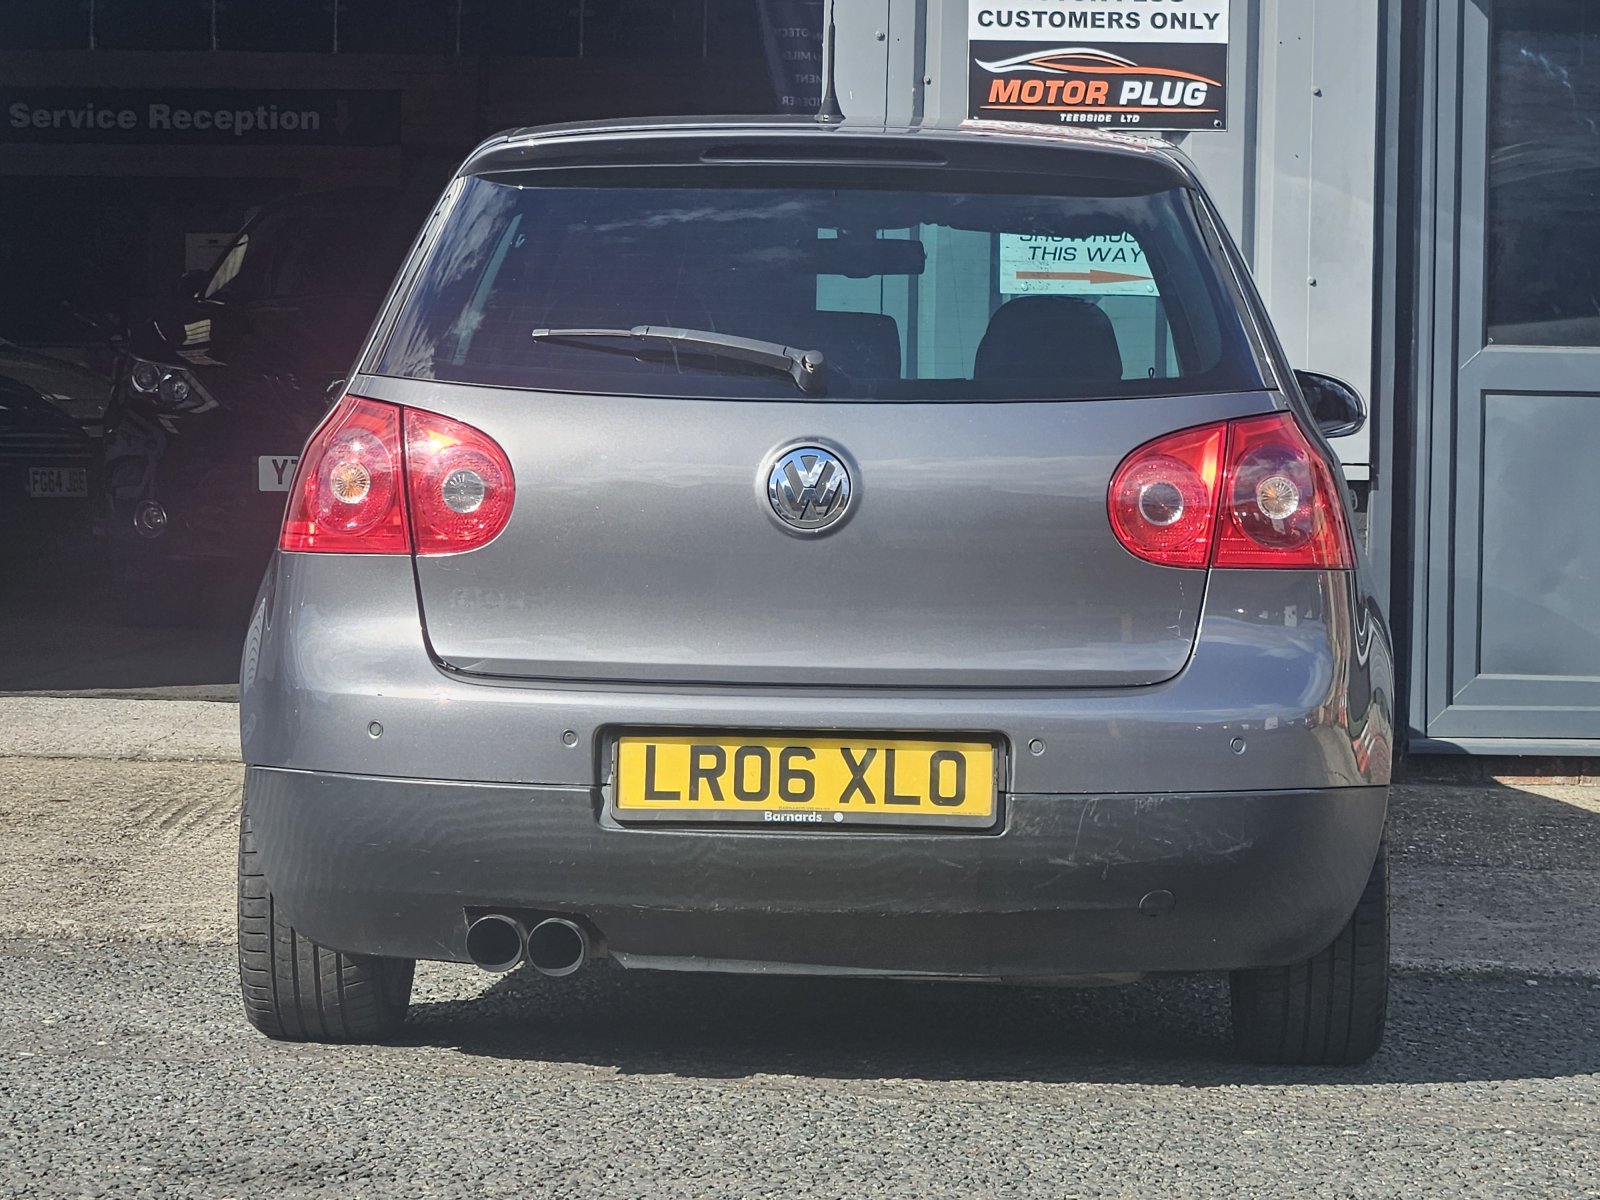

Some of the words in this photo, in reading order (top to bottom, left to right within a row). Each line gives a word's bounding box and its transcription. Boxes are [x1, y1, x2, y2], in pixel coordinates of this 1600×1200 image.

[978, 10, 1141, 30] CUSTOMERS
[1150, 12, 1220, 31] ONLY
[988, 79, 1110, 106] MOTOR
[1119, 81, 1208, 107] PLUG
[8, 102, 138, 129] Service
[149, 103, 321, 136] Reception
[1060, 113, 1112, 123] TEESSIDE
[1120, 114, 1141, 123] LTD
[1028, 246, 1078, 261] THIS
[1086, 247, 1142, 263] WAY
[644, 744, 816, 803] LR06
[838, 747, 967, 807] XLO
[764, 810, 823, 823] Barnards
